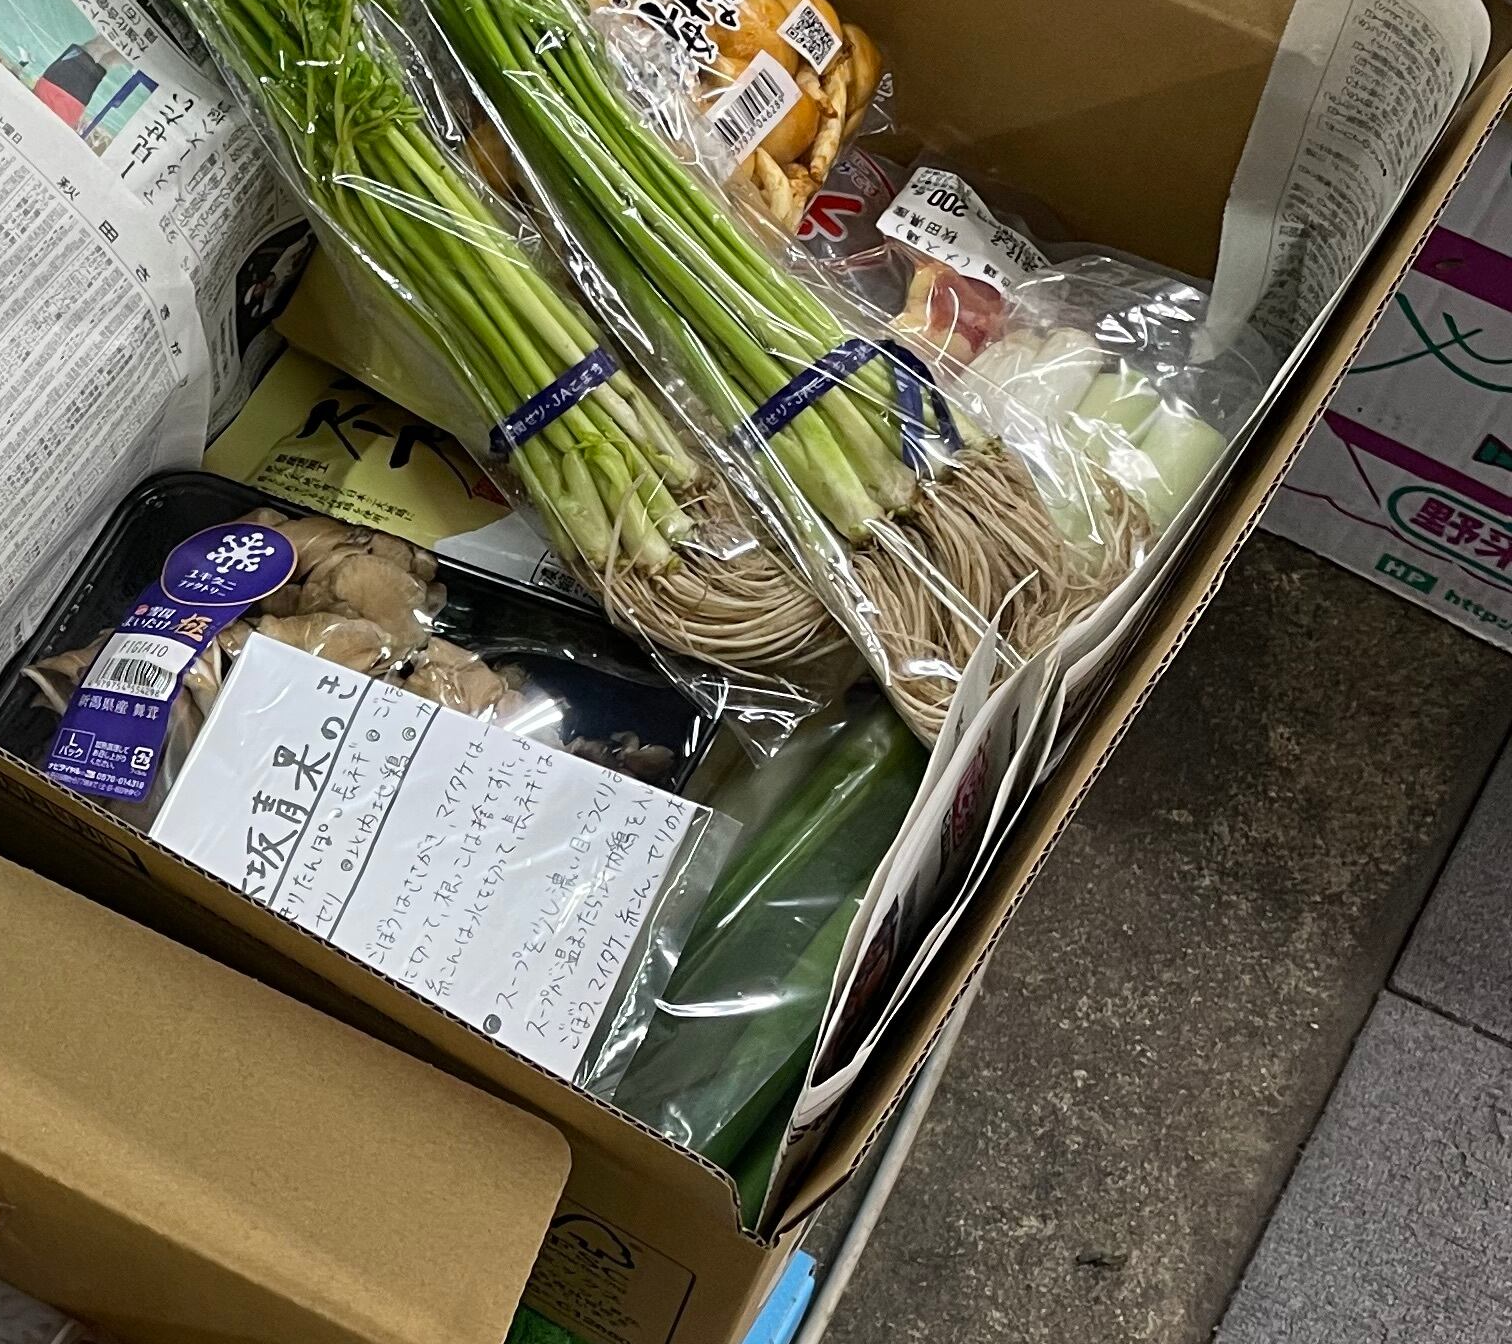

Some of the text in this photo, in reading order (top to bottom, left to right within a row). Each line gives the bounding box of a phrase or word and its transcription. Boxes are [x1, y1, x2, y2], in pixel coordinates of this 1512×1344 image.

[927, 186, 969, 219] 200
[78, 694, 128, 713] 新潟県産
[59, 746, 83, 758] パック
